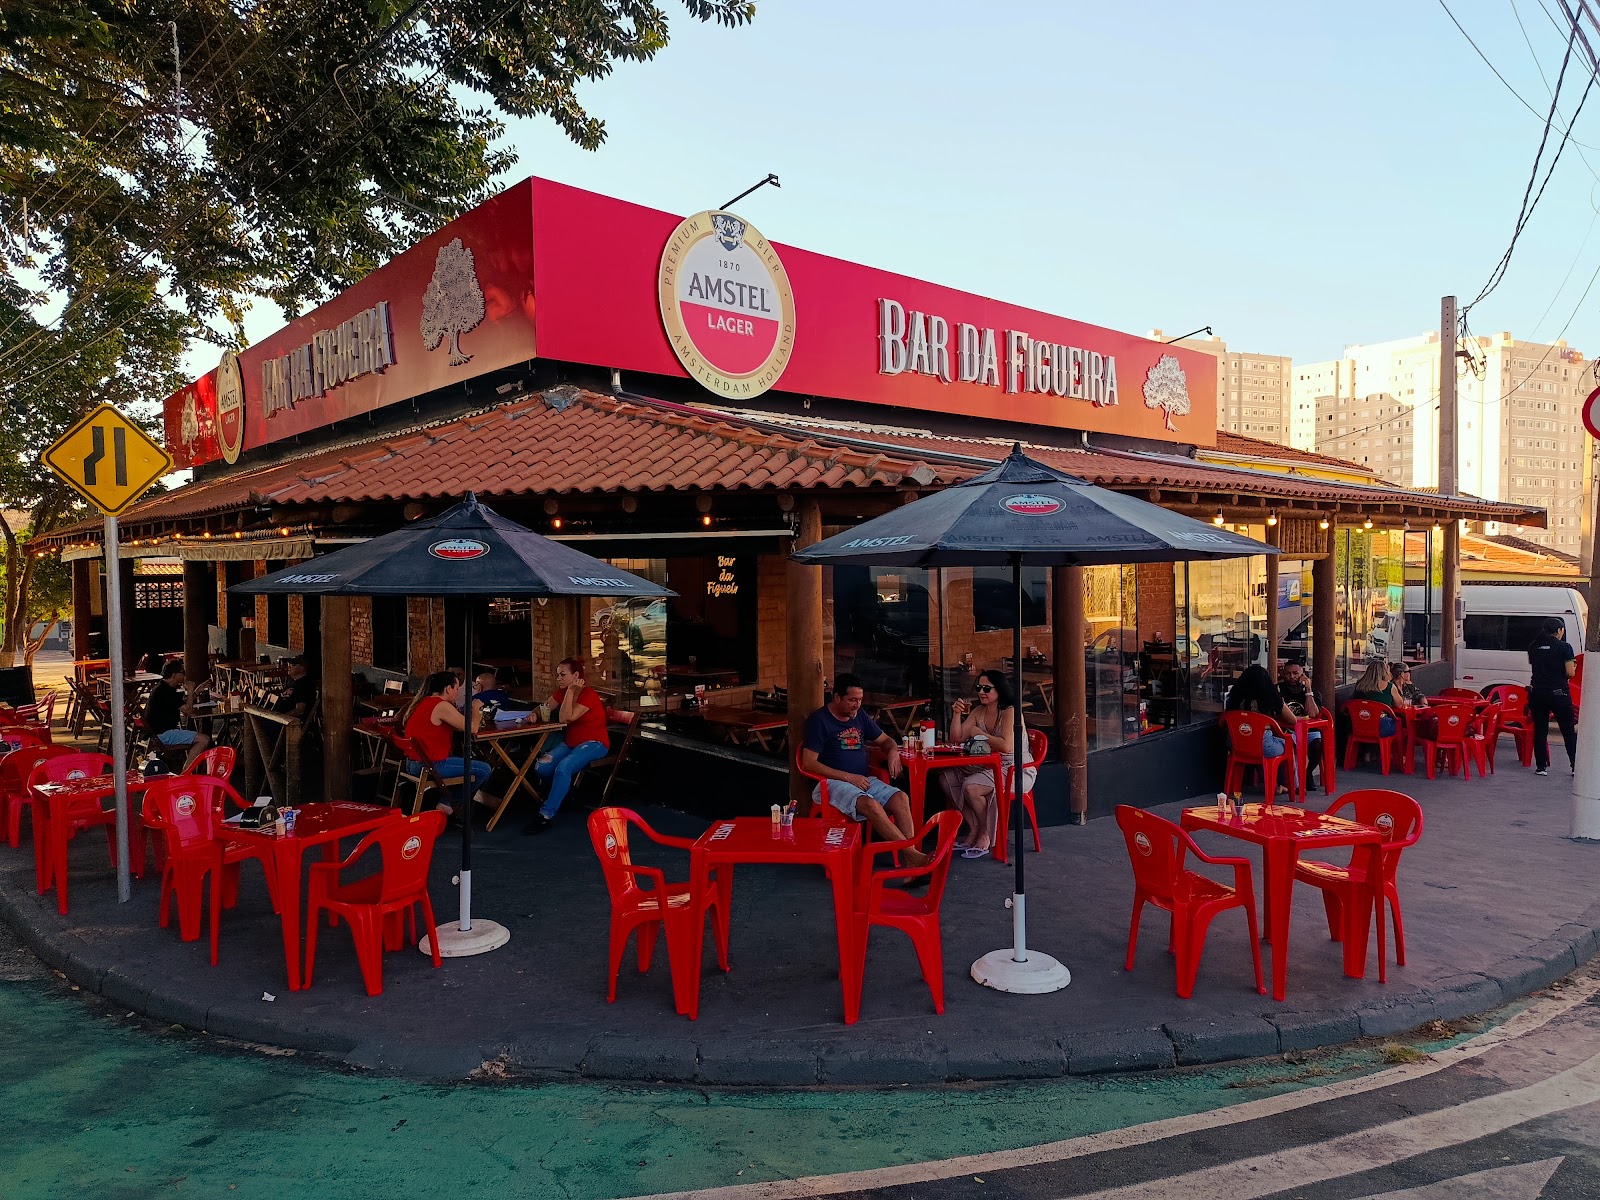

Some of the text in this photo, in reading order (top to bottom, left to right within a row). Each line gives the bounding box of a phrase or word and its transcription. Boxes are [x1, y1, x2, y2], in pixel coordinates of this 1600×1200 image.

[664, 221, 700, 286] PREMIUM
[718, 259, 740, 272] 1870
[756, 240, 780, 273] BIER
[688, 272, 771, 313] AMSTEL
[707, 312, 755, 336] LAGER
[673, 334, 751, 393] AMSTERDAM
[758, 323, 793, 388] HOLLAND
[877, 297, 1120, 408] BAR DA FIGUEIRA
[221, 388, 238, 409] AMSTEL
[840, 533, 919, 548] AMSTEL
[567, 575, 635, 588] AMSTEL
